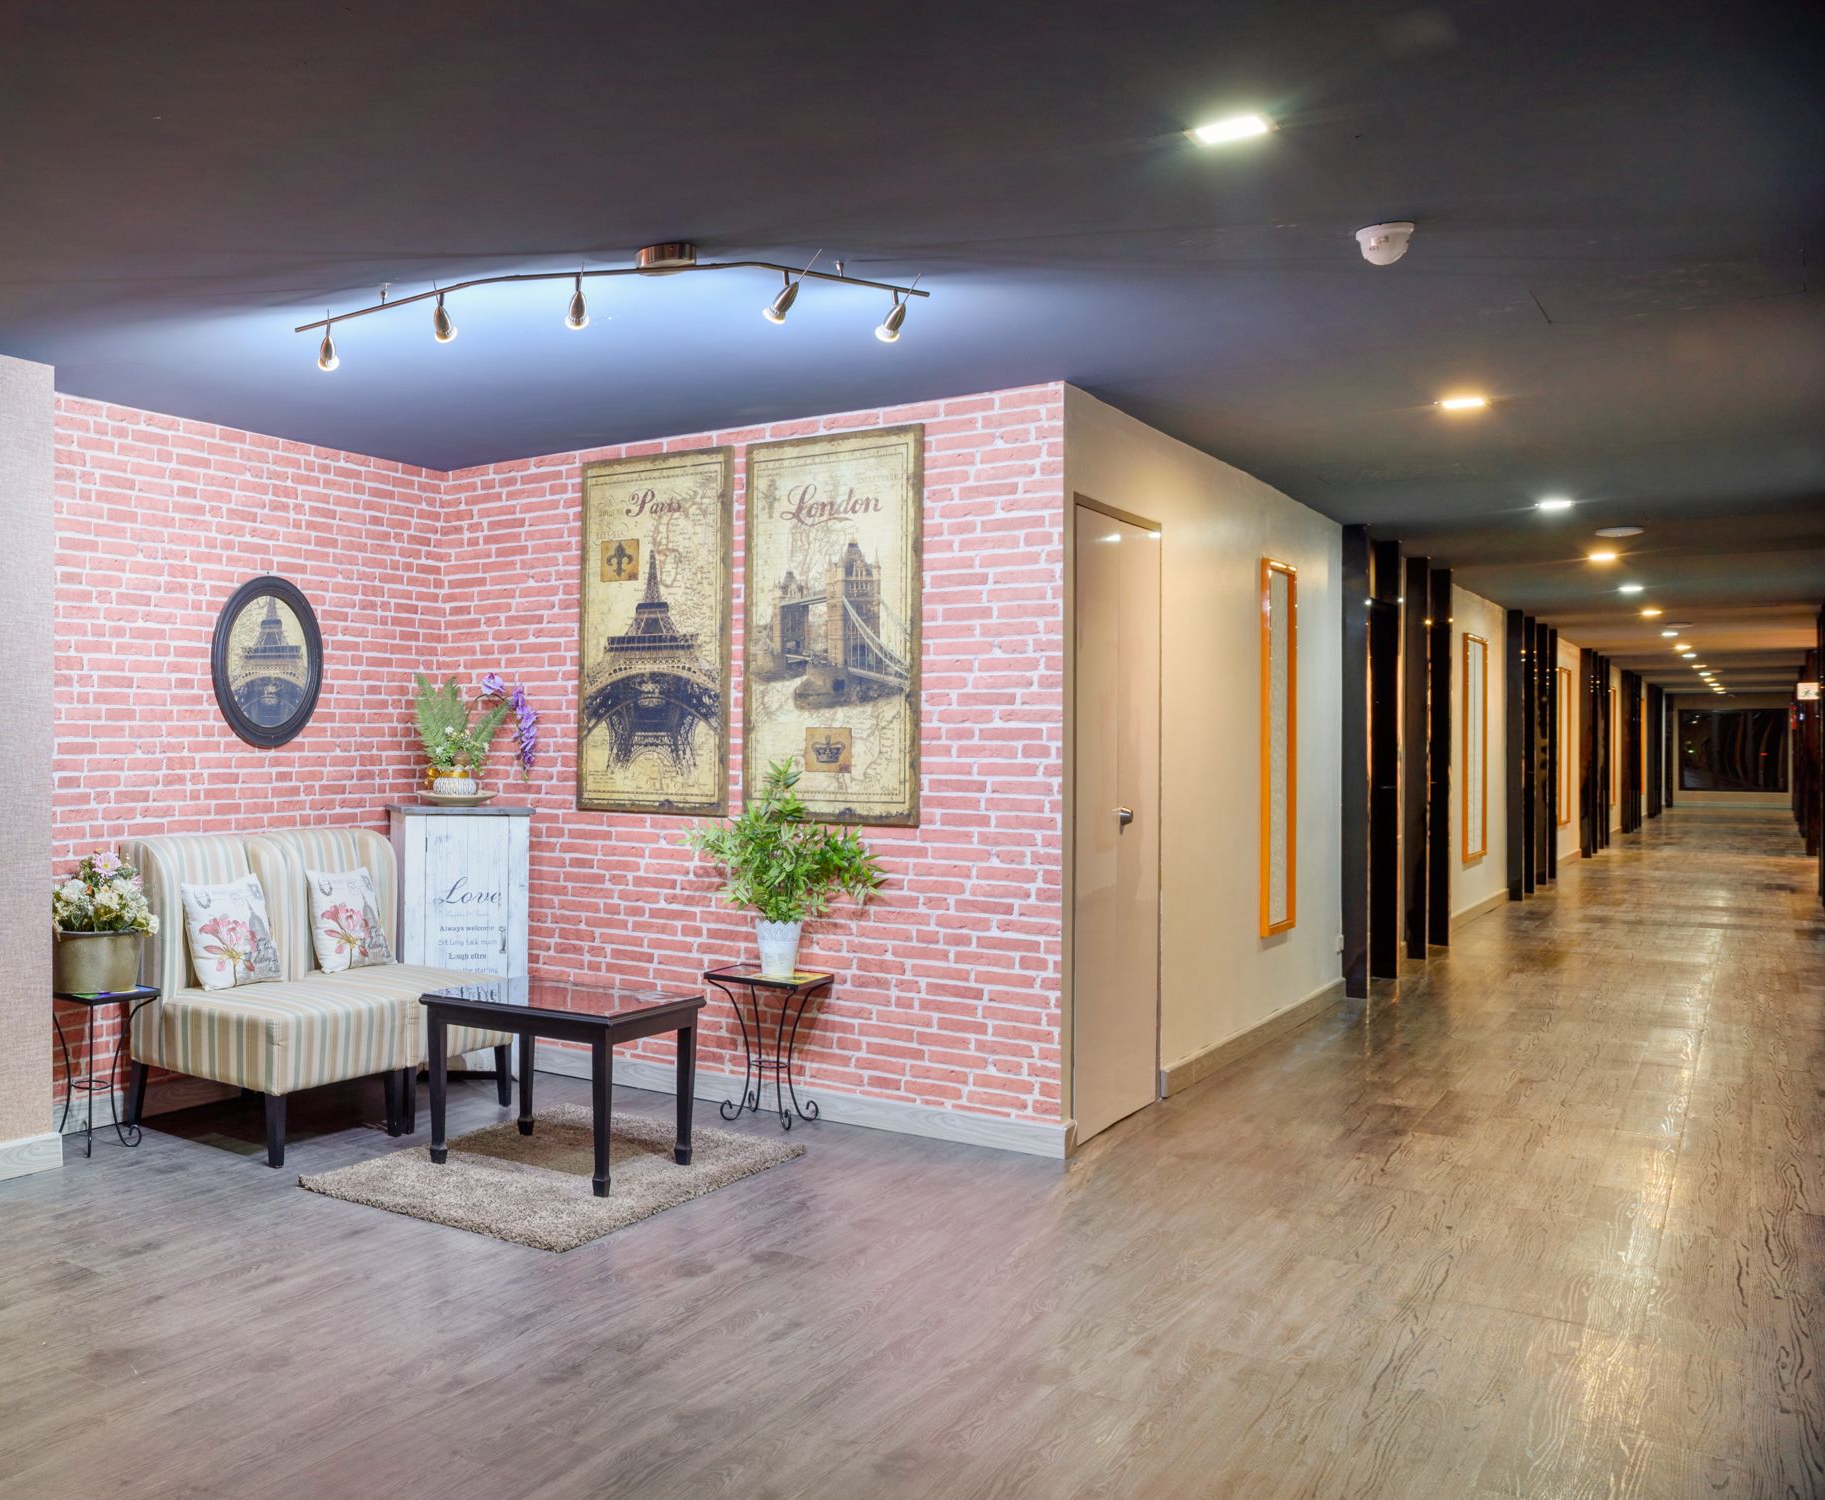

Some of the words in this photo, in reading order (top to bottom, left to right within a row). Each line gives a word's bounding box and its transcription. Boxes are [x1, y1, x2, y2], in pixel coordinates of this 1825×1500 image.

[625, 487, 682, 518] Paris
[780, 483, 883, 527] London
[433, 876, 502, 904] Love
[439, 925, 465, 933] Always
